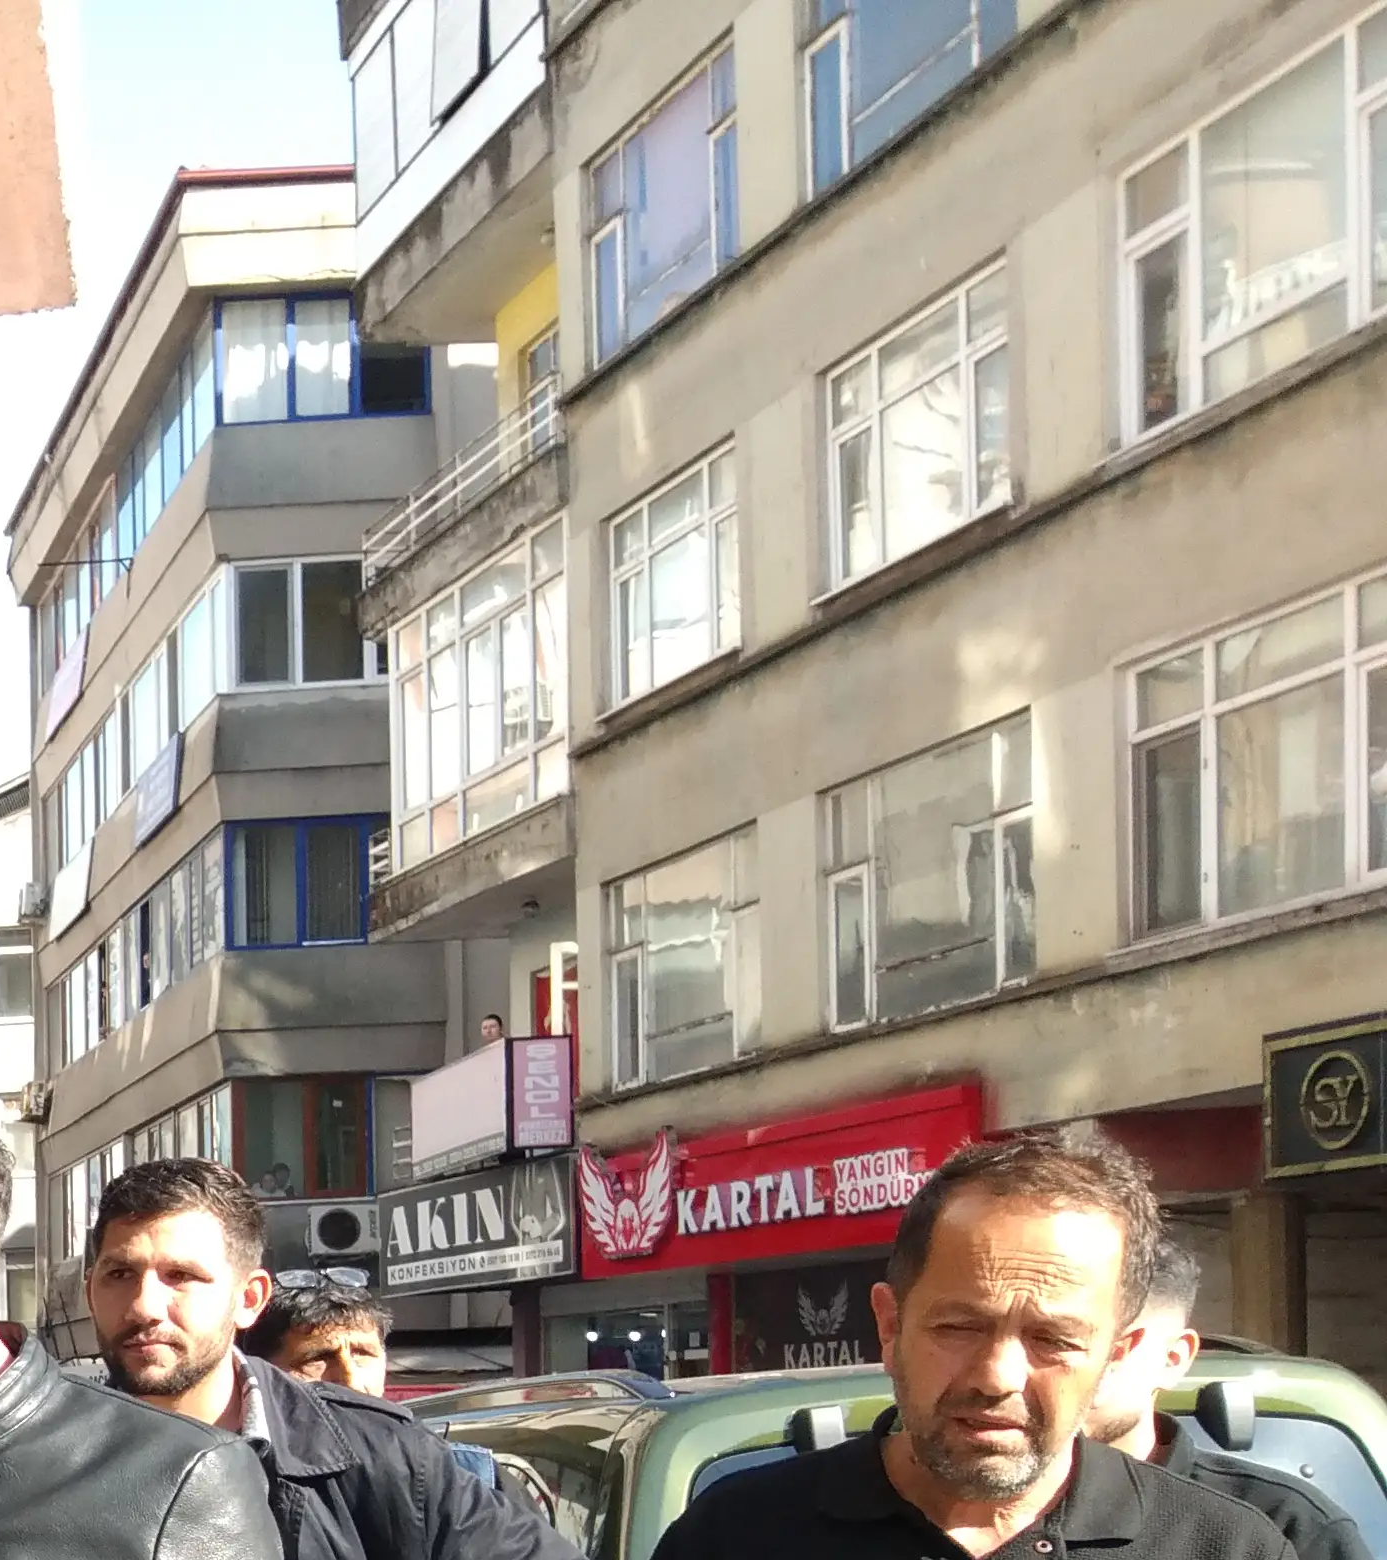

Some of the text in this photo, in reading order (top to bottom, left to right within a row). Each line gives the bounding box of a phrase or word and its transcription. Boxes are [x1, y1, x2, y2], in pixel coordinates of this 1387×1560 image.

[836, 1151, 905, 1184] YANGIN
[386, 1185, 506, 1258] AKIN
[676, 1166, 825, 1236] KARTAL
[783, 1339, 865, 1370] KARTAL
